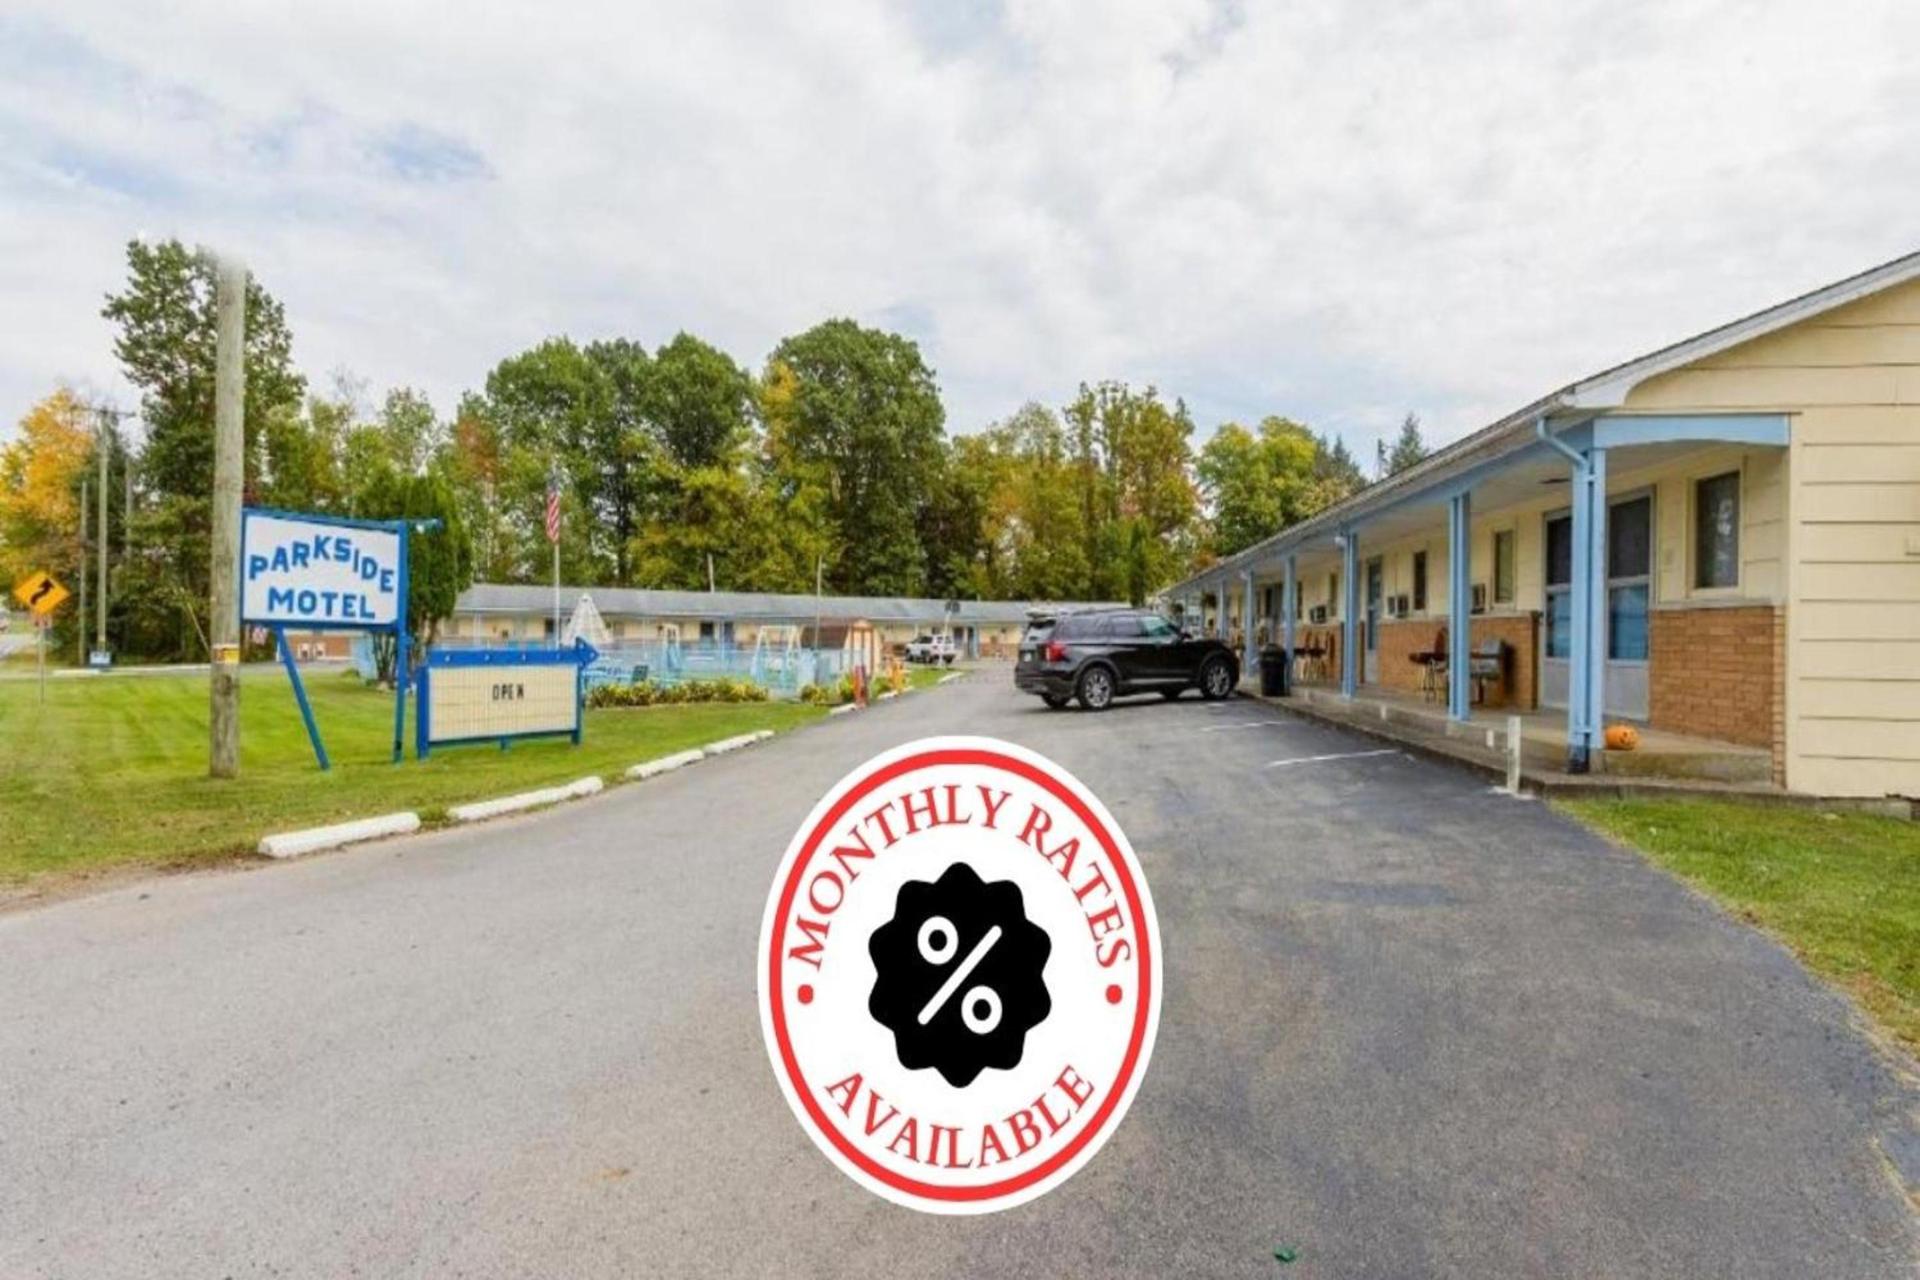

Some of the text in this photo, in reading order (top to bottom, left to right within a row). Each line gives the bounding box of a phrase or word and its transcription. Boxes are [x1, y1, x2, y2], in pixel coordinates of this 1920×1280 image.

[249, 535, 394, 593] PARKSIDE
[267, 586, 376, 620] MOTEL
[492, 682, 525, 701] OPEN
